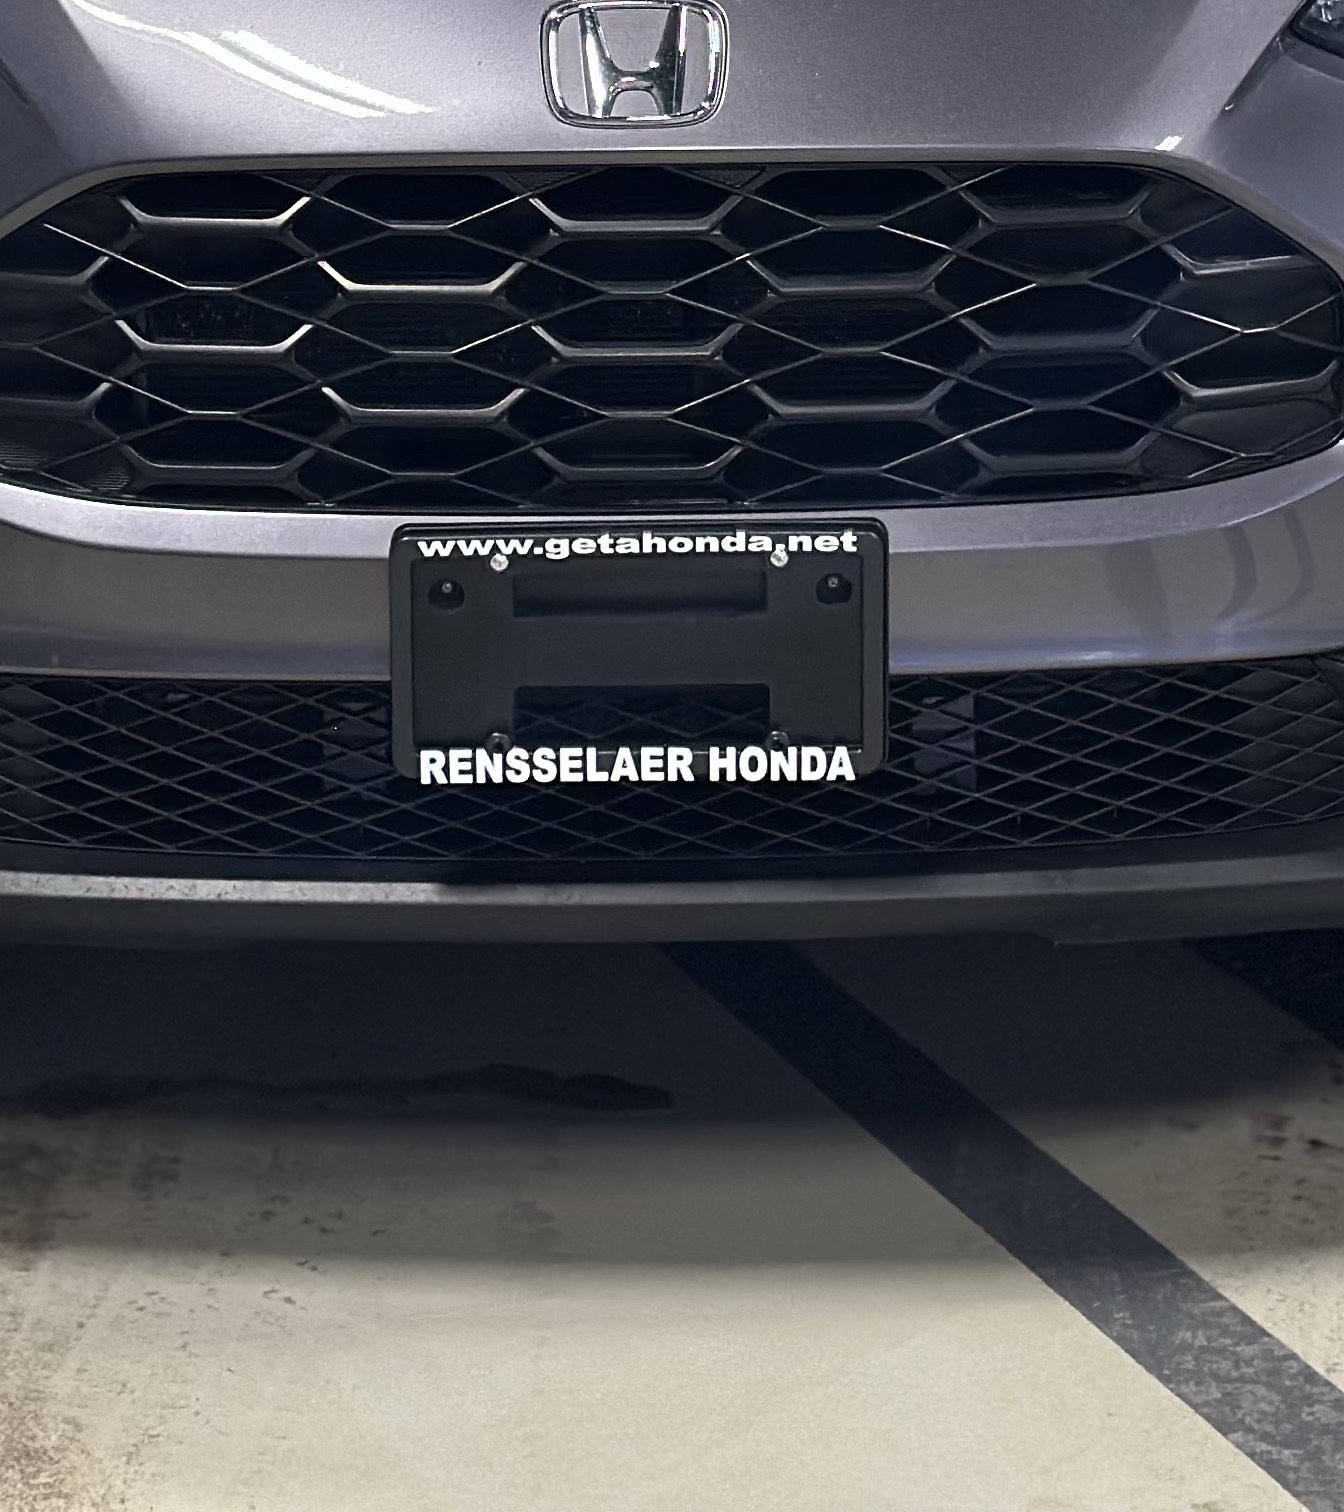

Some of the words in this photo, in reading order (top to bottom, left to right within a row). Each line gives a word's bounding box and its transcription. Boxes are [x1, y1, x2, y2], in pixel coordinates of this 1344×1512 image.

[417, 529, 858, 560] www.getahonda.net
[419, 746, 695, 785] RENSSELAER
[708, 745, 856, 782] HONDA
